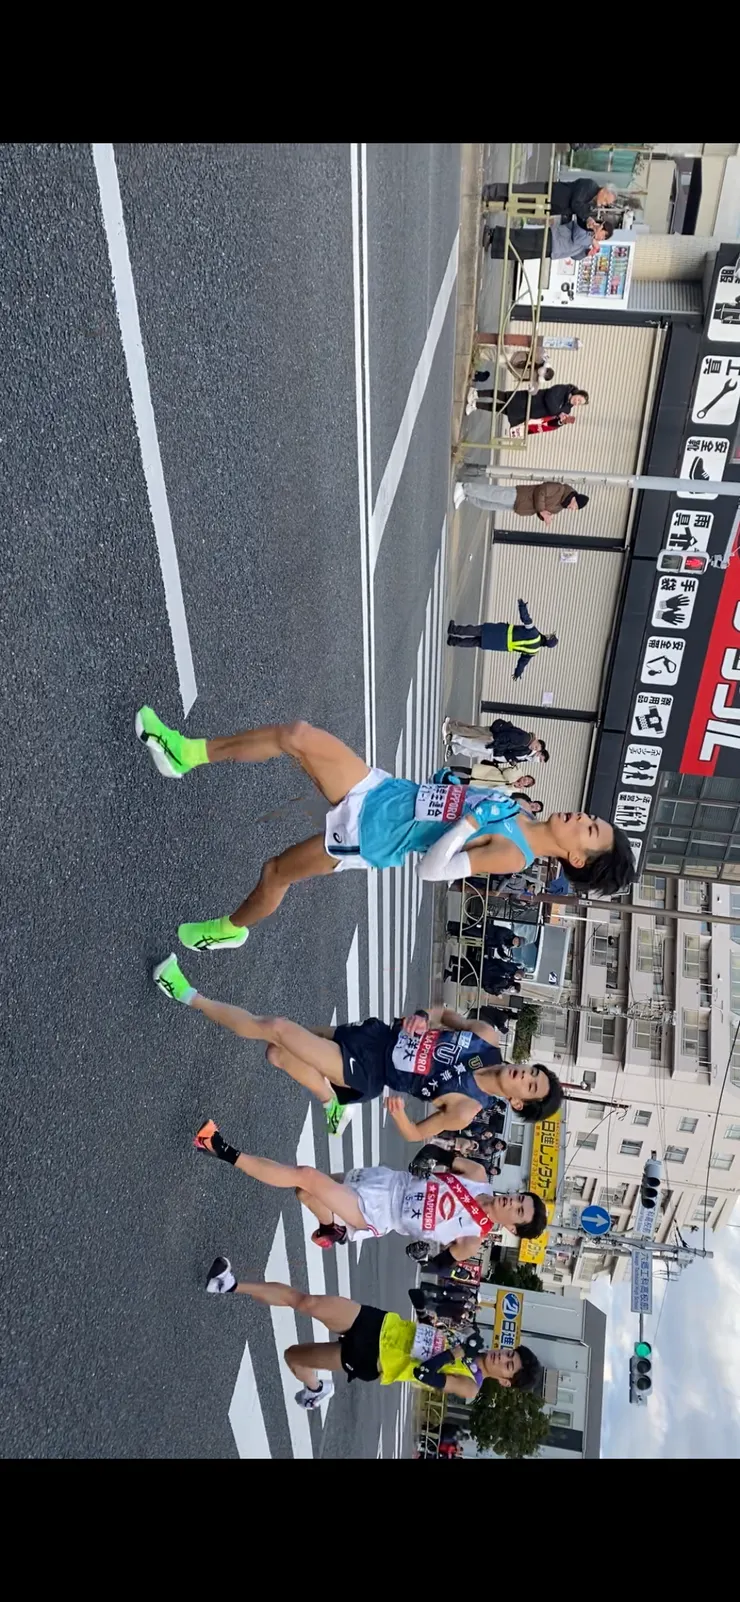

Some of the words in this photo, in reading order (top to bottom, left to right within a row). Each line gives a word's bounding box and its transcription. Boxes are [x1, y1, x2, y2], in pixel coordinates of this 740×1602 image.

[686, 440, 728, 453] 安全靴
[673, 512, 711, 528] 雨具
[660, 578, 696, 592] 手袋
[648, 639, 683, 651] 安全帯
[637, 695, 672, 706] 祭用品
[417, 1034, 434, 1072] SAPPORO
[537, 1120, 556, 1198] 日進レンタカー
[424, 1194, 436, 1228] SAPPORO
[640, 1252, 650, 1310] 六郷工科高校前
